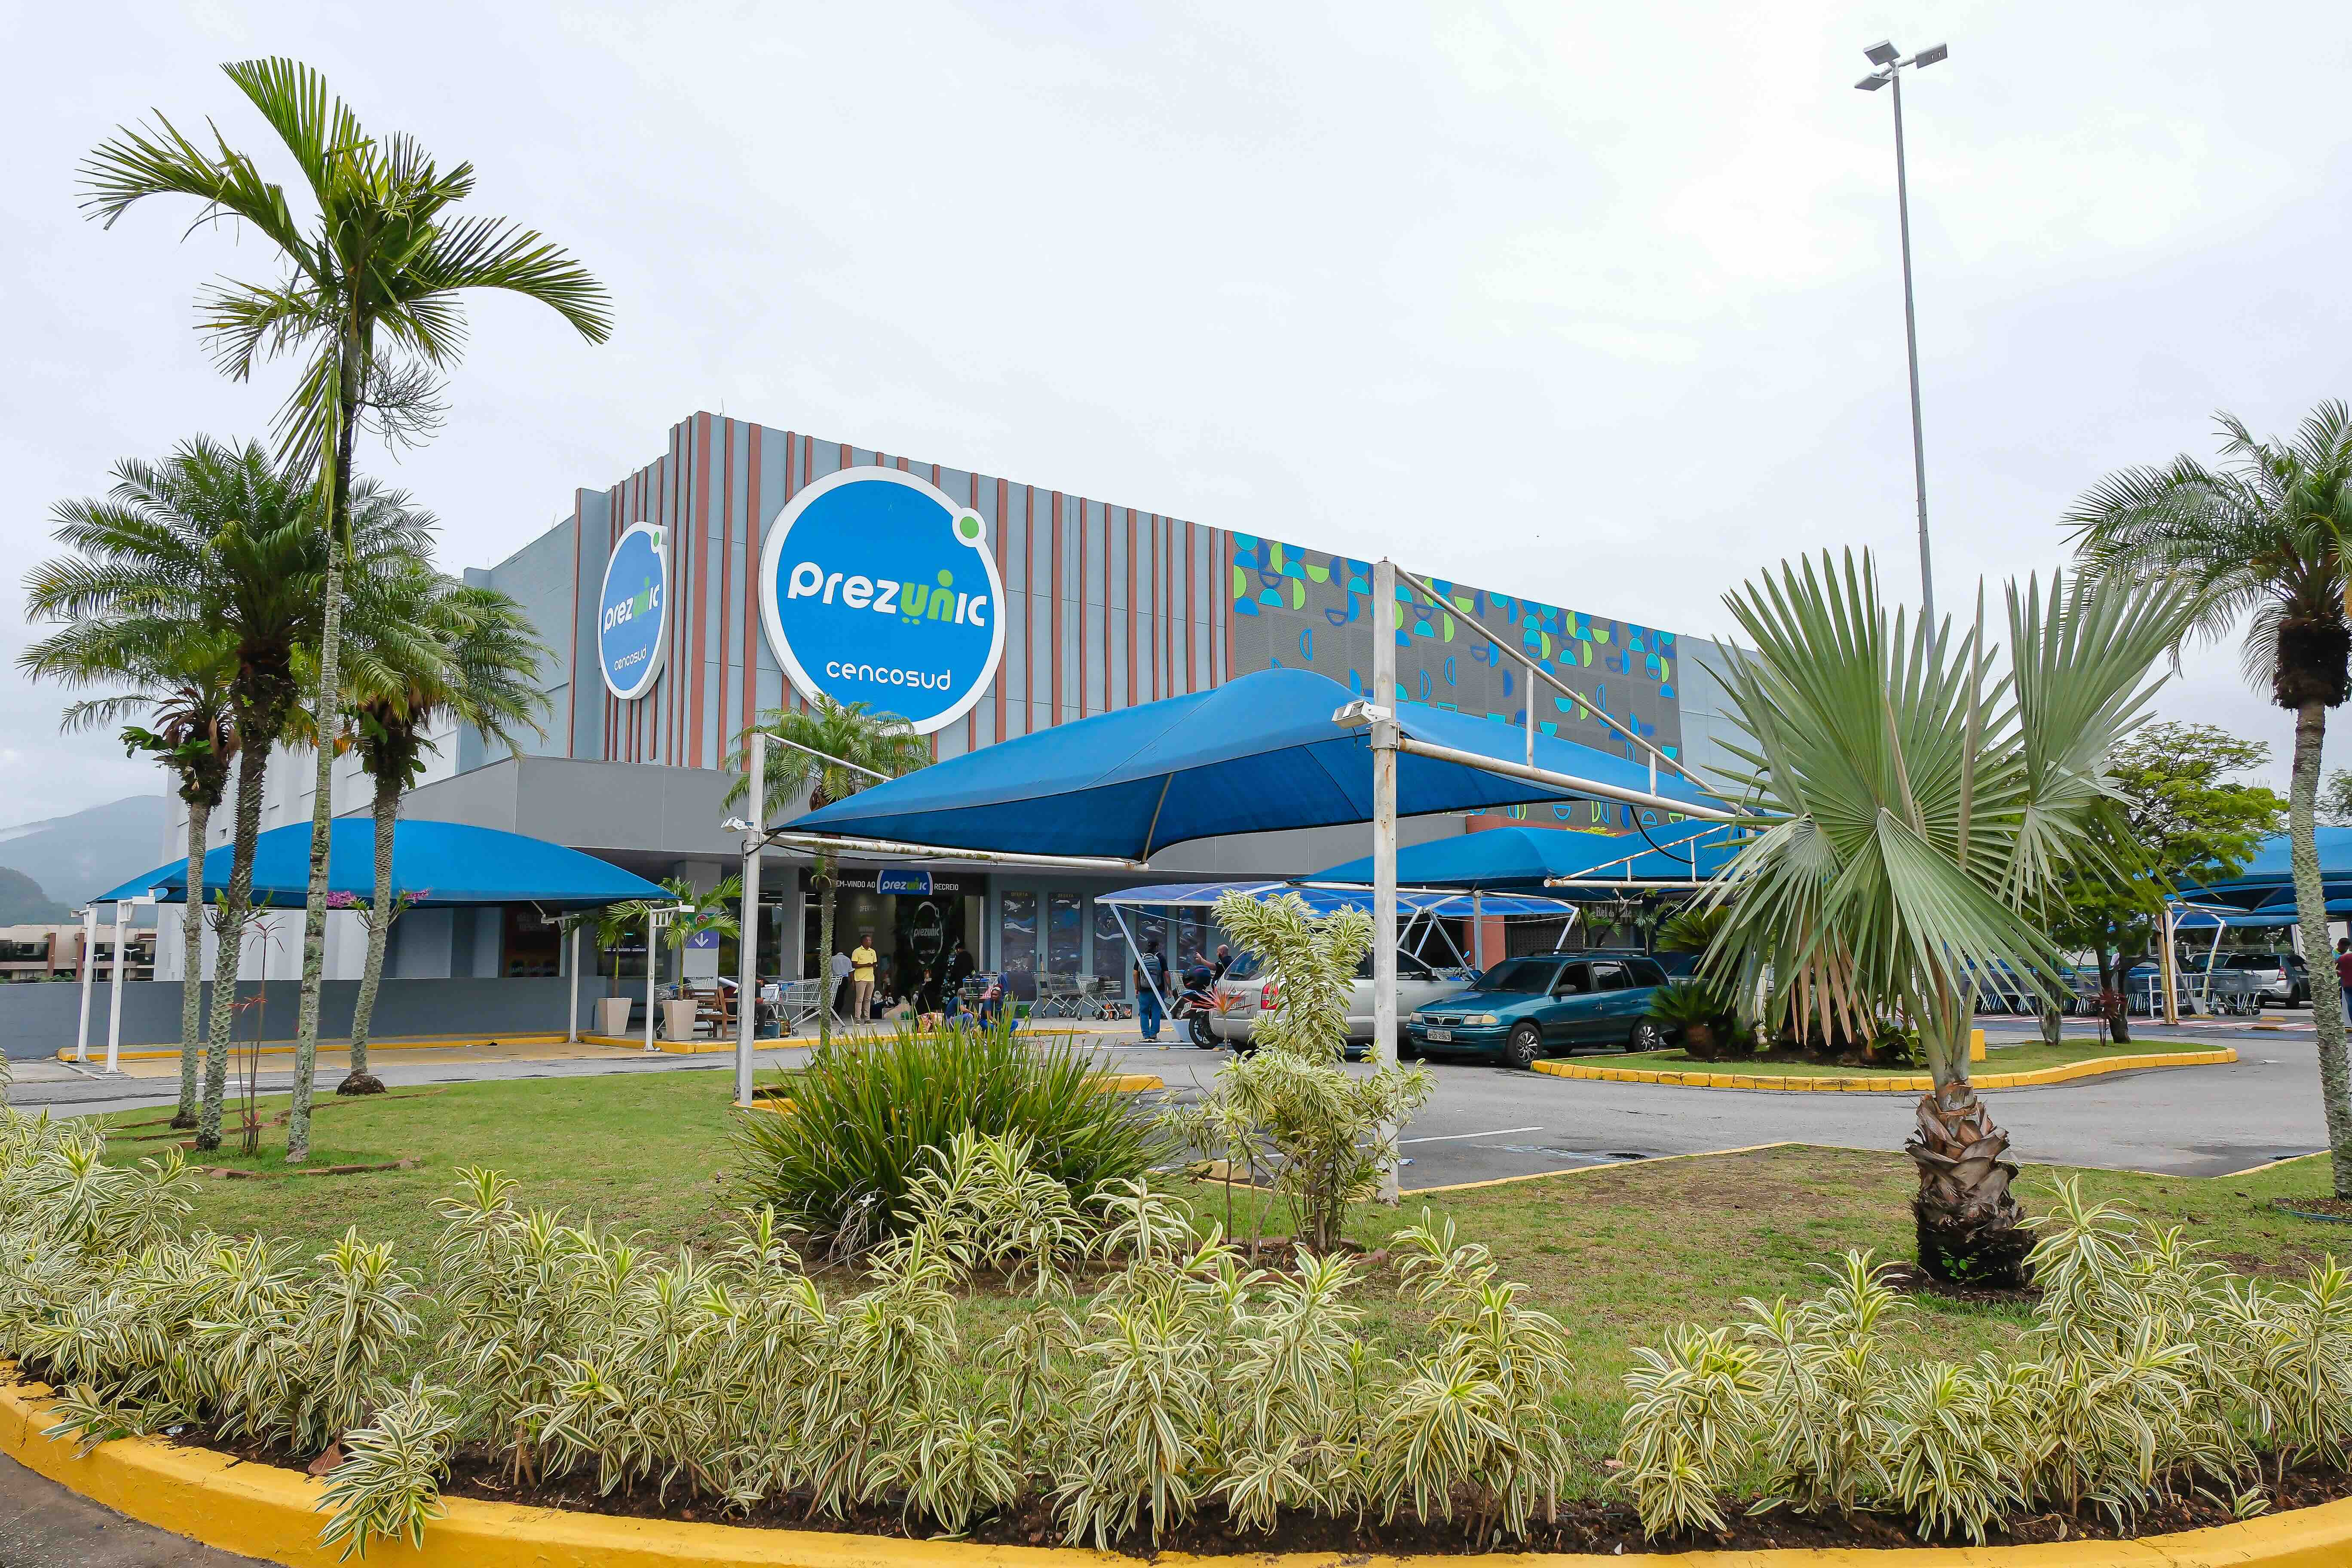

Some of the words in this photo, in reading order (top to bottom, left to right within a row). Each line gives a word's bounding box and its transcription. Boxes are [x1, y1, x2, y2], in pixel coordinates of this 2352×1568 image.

[787, 561, 987, 627] prezunic
[614, 644, 647, 671] cencosud
[826, 661, 951, 690] cencosud
